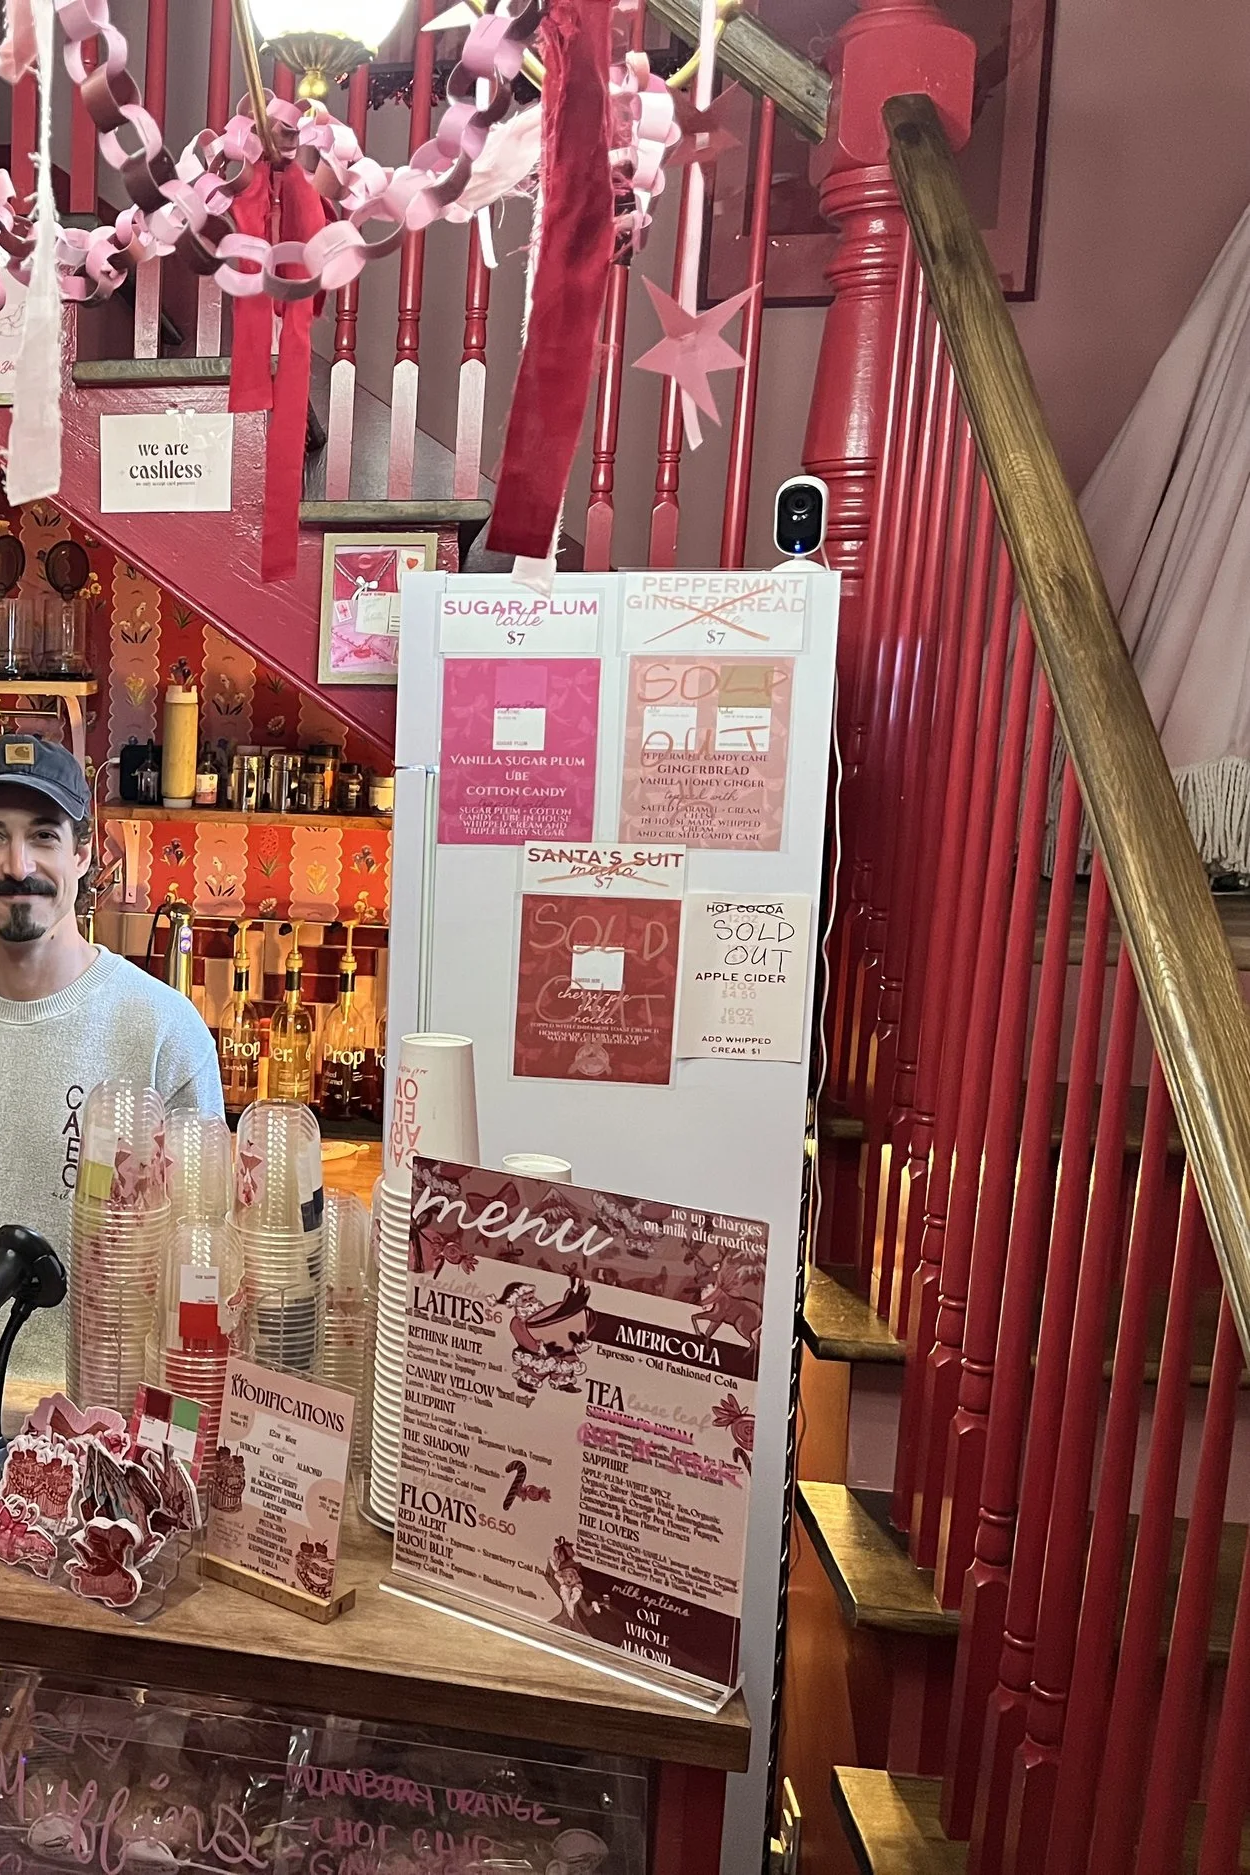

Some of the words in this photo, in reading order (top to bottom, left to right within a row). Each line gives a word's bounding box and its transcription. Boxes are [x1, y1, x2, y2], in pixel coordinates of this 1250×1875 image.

[138, 443, 159, 456] we
[164, 443, 189, 456] are
[129, 459, 203, 479] cashless
[642, 576, 804, 595] PEPPERMINT
[444, 600, 523, 615] SUGAR
[531, 600, 598, 615] PLUM
[626, 594, 807, 613] GINGERBREAD
[507, 630, 526, 646] $7
[706, 629, 726, 645] $7
[450, 753, 502, 766] VANILLA
[505, 755, 547, 767] SUGAR
[550, 756, 585, 767] PLUM
[703, 753, 739, 762] CANDY
[505, 770, 530, 782] UBE
[657, 764, 750, 776] GINGERBREAD
[466, 786, 521, 796] COTTON
[523, 786, 567, 797] CANDY
[723, 779, 764, 788] GINGER
[459, 806, 492, 815] SUGAR
[494, 807, 521, 816] PLUM
[529, 807, 572, 816] COTTON
[459, 813, 493, 822] CANDY
[462, 820, 507, 830] WHIPPED
[509, 821, 544, 830] CREAM
[465, 827, 497, 835] TRIPLE
[499, 828, 529, 837] BERRY
[532, 828, 565, 838] SUGAR
[636, 830, 657, 839] AND
[701, 832, 733, 840] CANDY
[527, 847, 622, 864] SANTA'S
[633, 851, 684, 868] SUIT
[706, 904, 732, 913] HOT
[736, 904, 784, 914] COCOA
[529, 903, 669, 962] SOLD
[713, 919, 795, 942] SOLD
[724, 945, 792, 973] OUT
[695, 972, 739, 981] APPLE
[744, 973, 786, 983] CIDER
[701, 1035, 722, 1043] ADD
[725, 1036, 772, 1045] WHIPPED
[412, 1185, 615, 1257] menu
[671, 1208, 687, 1221] no
[690, 1212, 707, 1229] up
[711, 1214, 764, 1237] charges
[662, 1221, 689, 1239] milk
[691, 1229, 768, 1255] alternatives
[413, 1285, 484, 1326] LATTES
[484, 1308, 503, 1325] $6
[408, 1324, 448, 1347] RETHINK
[451, 1335, 484, 1356] HAUTE
[615, 1324, 721, 1367] AMERICOLA
[596, 1345, 635, 1364] Espresso
[645, 1357, 664, 1371] Old
[666, 1362, 711, 1384] Fashioned
[714, 1374, 738, 1391] Cola
[405, 1363, 447, 1386] CANARY
[450, 1374, 496, 1401] YELLOW
[405, 1388, 456, 1415] BLUEPRINT
[586, 1378, 625, 1413] TEA
[231, 1379, 345, 1434] MODIFICATIONS
[403, 1427, 421, 1444] THE
[423, 1434, 470, 1458] SHADOW
[582, 1451, 629, 1475] SAPPHIRE
[398, 1506, 416, 1523] RED
[418, 1513, 448, 1534] ALERT
[400, 1482, 477, 1529] FLOATS
[478, 1513, 516, 1537] $6.50
[578, 1512, 597, 1528] THE
[599, 1518, 640, 1542] LOVERS
[429, 1540, 454, 1561] BLUE
[611, 1582, 641, 1600] milk
[643, 1595, 691, 1618] options
[636, 1608, 661, 1627] OAT
[625, 1621, 670, 1648] WHOLE
[620, 1639, 671, 1666] ALMOND
